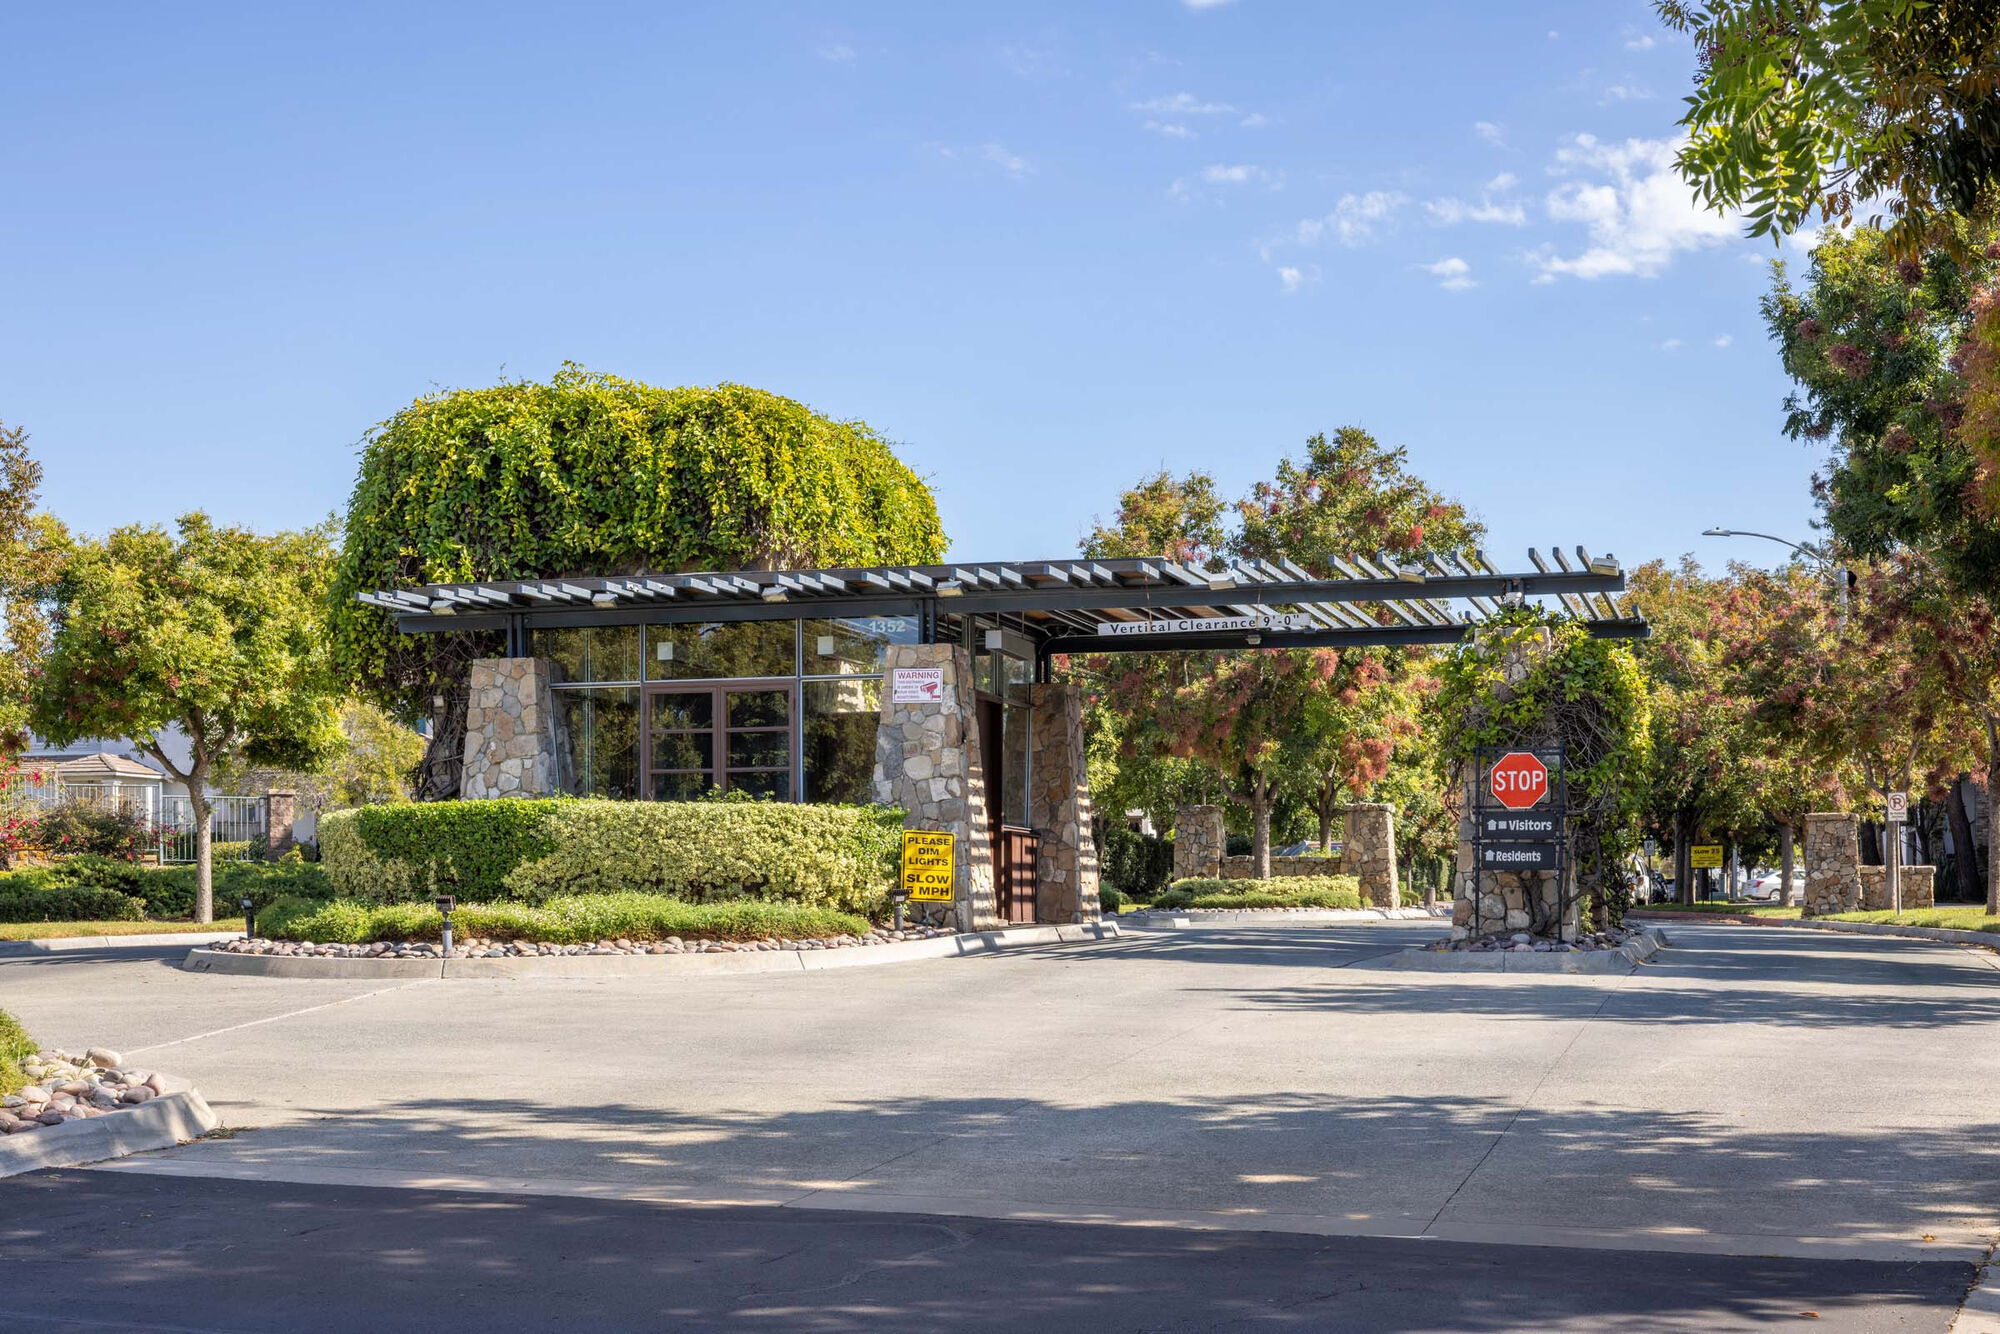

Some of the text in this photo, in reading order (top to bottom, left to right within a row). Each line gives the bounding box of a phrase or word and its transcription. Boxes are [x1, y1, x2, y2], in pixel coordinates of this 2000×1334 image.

[869, 619, 906, 633] 1352
[1110, 621, 1171, 634] Vertical
[1178, 619, 1256, 631] Clearance
[897, 671, 939, 679] WARNING
[1494, 770, 1544, 791] STOP
[1508, 819, 1552, 831] Visitors
[907, 837, 950, 846] PLEASE
[918, 847, 939, 855] DIM
[1495, 850, 1542, 862] Residents
[908, 857, 949, 866] LIGHTS
[906, 873, 950, 885] SLOW
[919, 886, 950, 896] MPH
